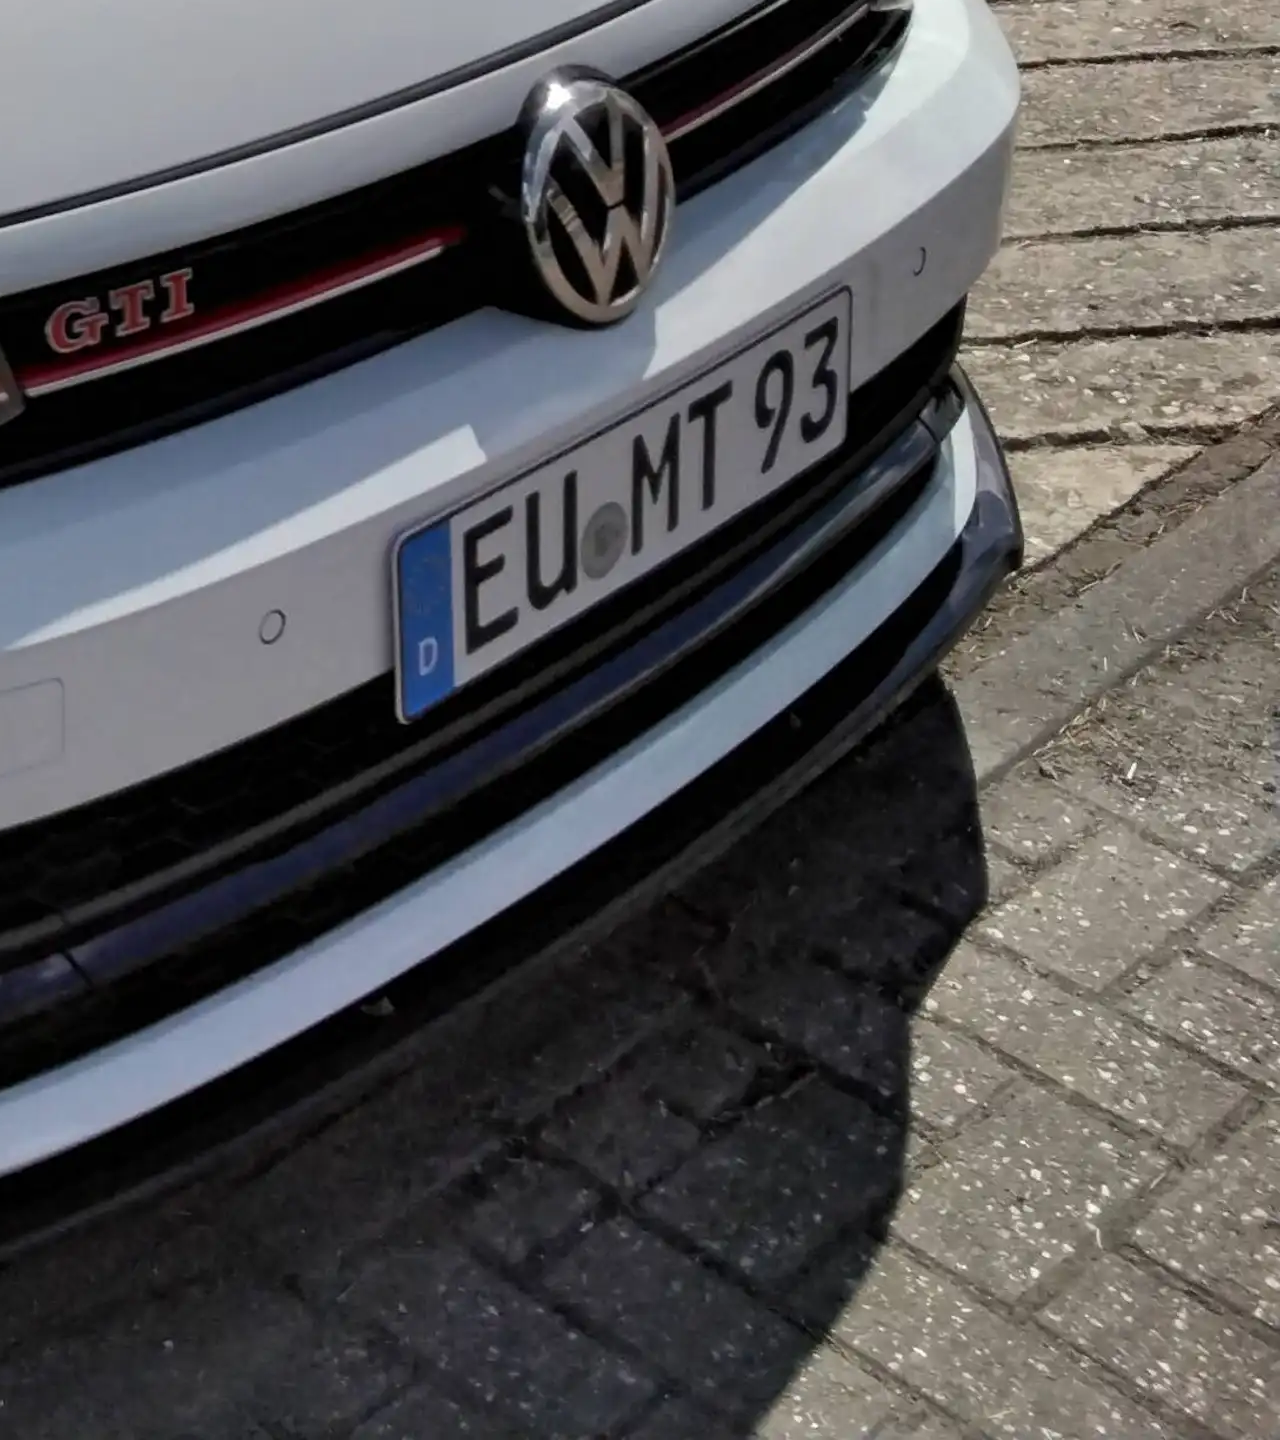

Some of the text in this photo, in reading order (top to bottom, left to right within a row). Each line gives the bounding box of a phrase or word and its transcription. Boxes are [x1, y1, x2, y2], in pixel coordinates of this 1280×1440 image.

[531, 76, 669, 319] VW
[44, 266, 196, 355] GTI
[463, 317, 839, 655] EU MT 93
[418, 637, 438, 676] D
